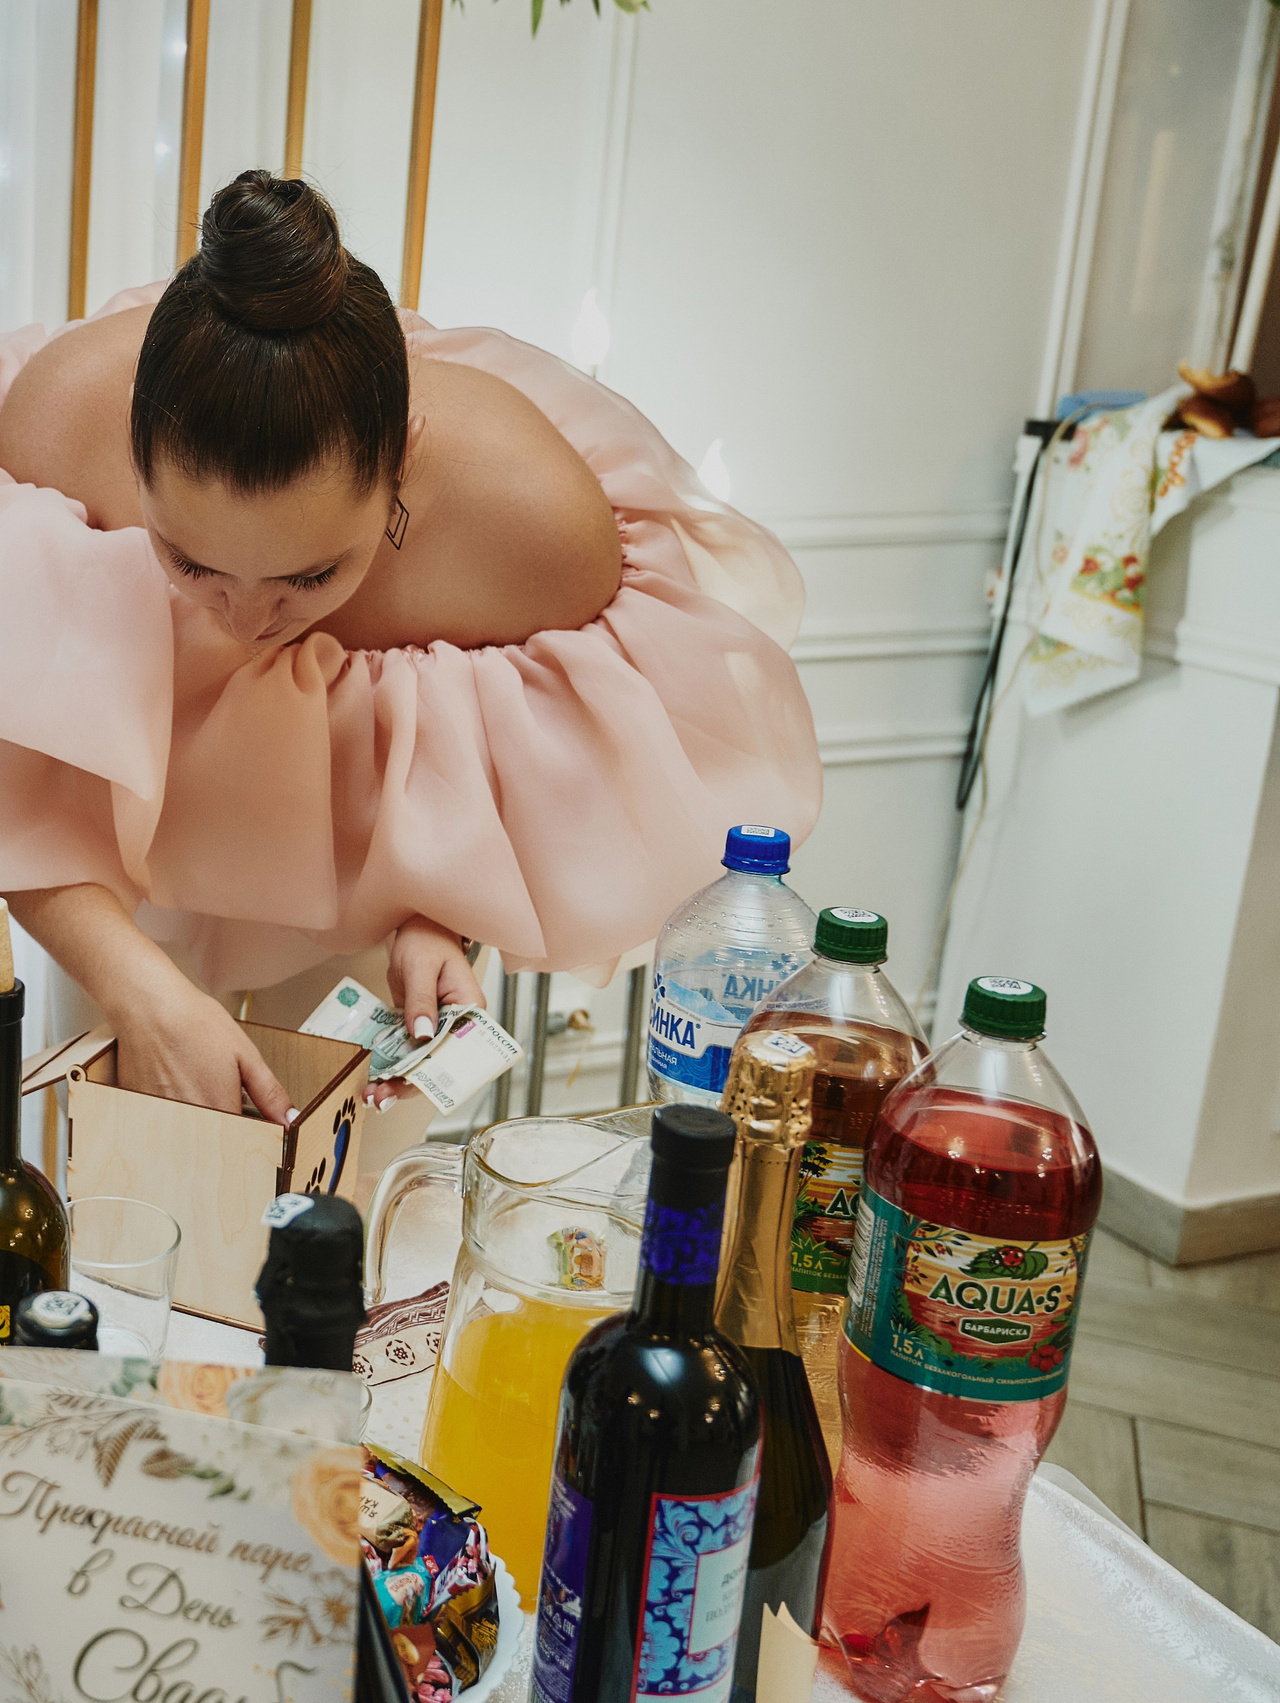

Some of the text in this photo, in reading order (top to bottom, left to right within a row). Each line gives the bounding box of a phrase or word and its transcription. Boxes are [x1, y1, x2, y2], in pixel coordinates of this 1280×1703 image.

[487, 1025, 518, 1054] РОССИИ
[964, 1322, 1028, 1336] БАРБАРИСКА
[227, 1538, 312, 1583] паре
[64, 1548, 240, 1628] в День
